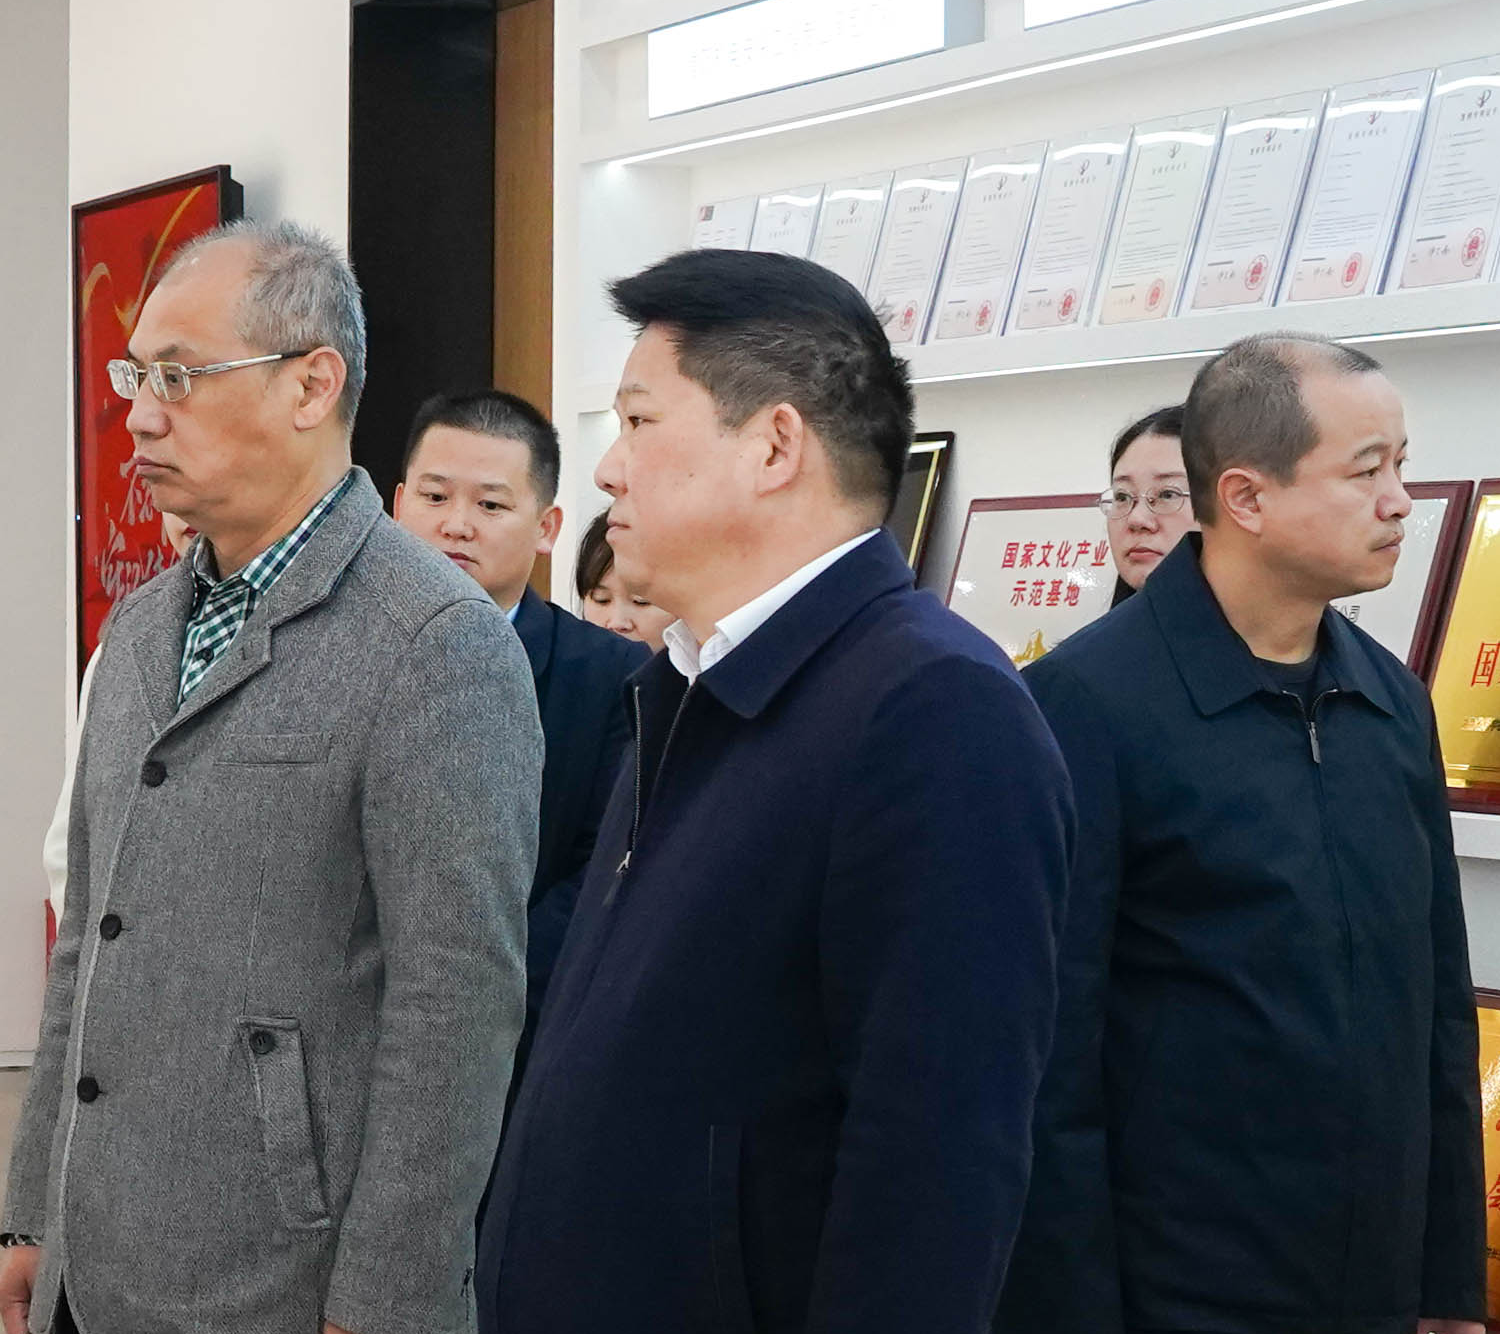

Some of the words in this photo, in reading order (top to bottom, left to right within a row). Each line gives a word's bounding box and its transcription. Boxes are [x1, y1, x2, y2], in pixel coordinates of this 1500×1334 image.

[1000, 539, 1109, 569] 国家文化产业
[1009, 579, 1081, 608] 示范基地
